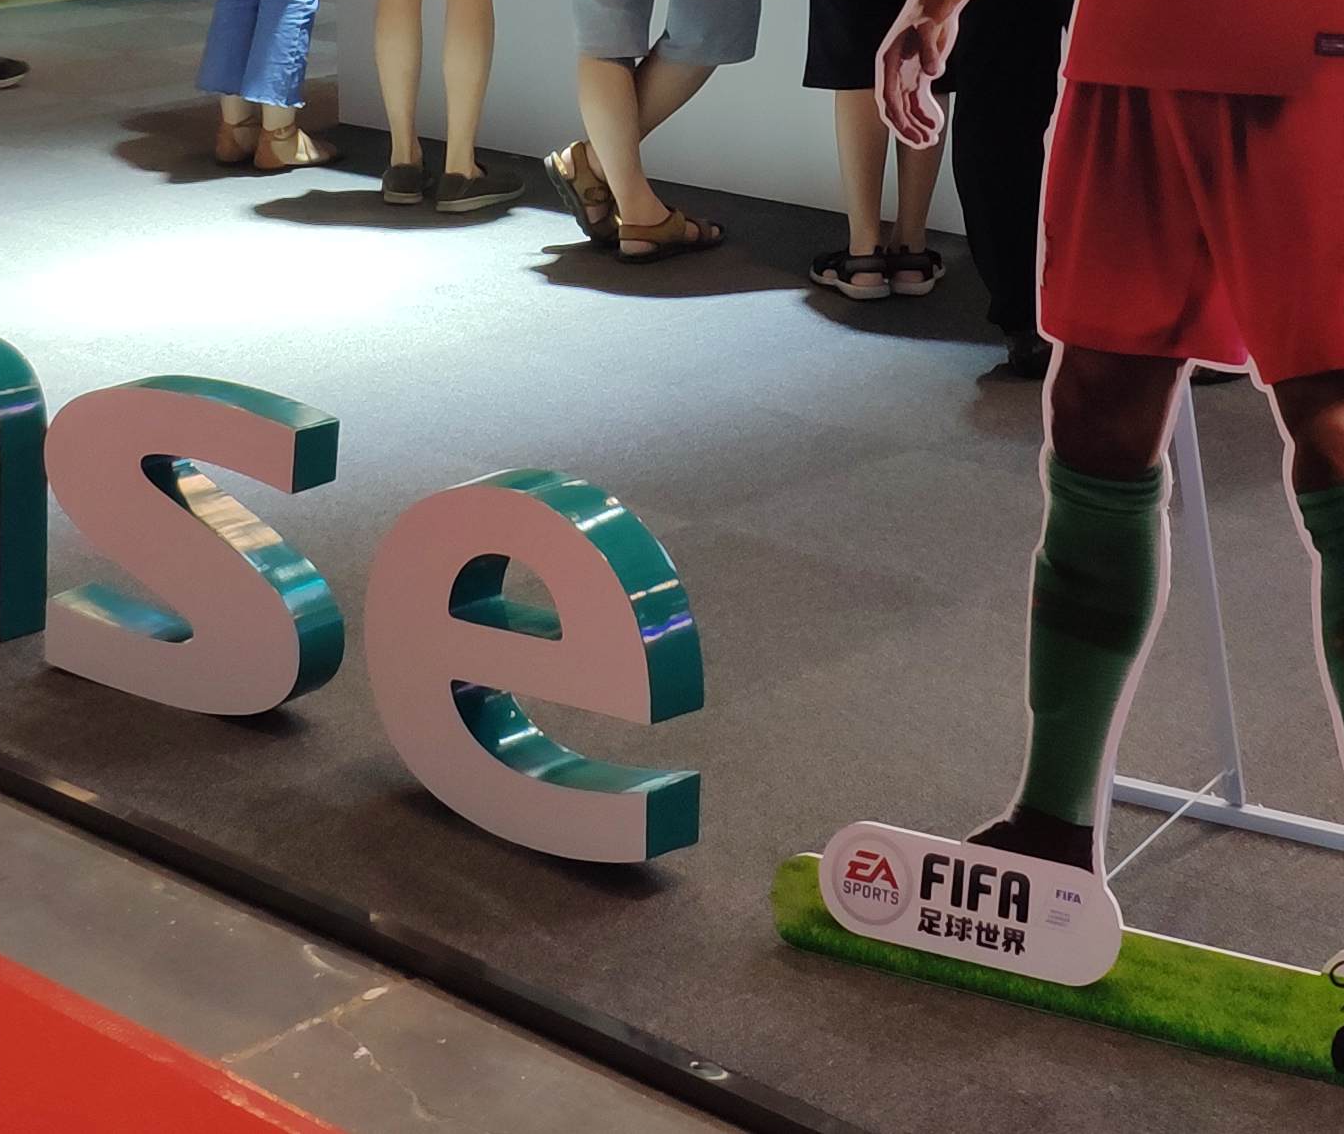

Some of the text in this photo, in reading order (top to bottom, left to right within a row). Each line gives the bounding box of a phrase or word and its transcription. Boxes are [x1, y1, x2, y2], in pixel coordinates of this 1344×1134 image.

[845, 849, 899, 890] EA
[919, 852, 1031, 924] FIFA
[842, 879, 900, 906] SPORTS
[1055, 889, 1082, 905] FIFA
[917, 906, 1026, 956] 足球世界
